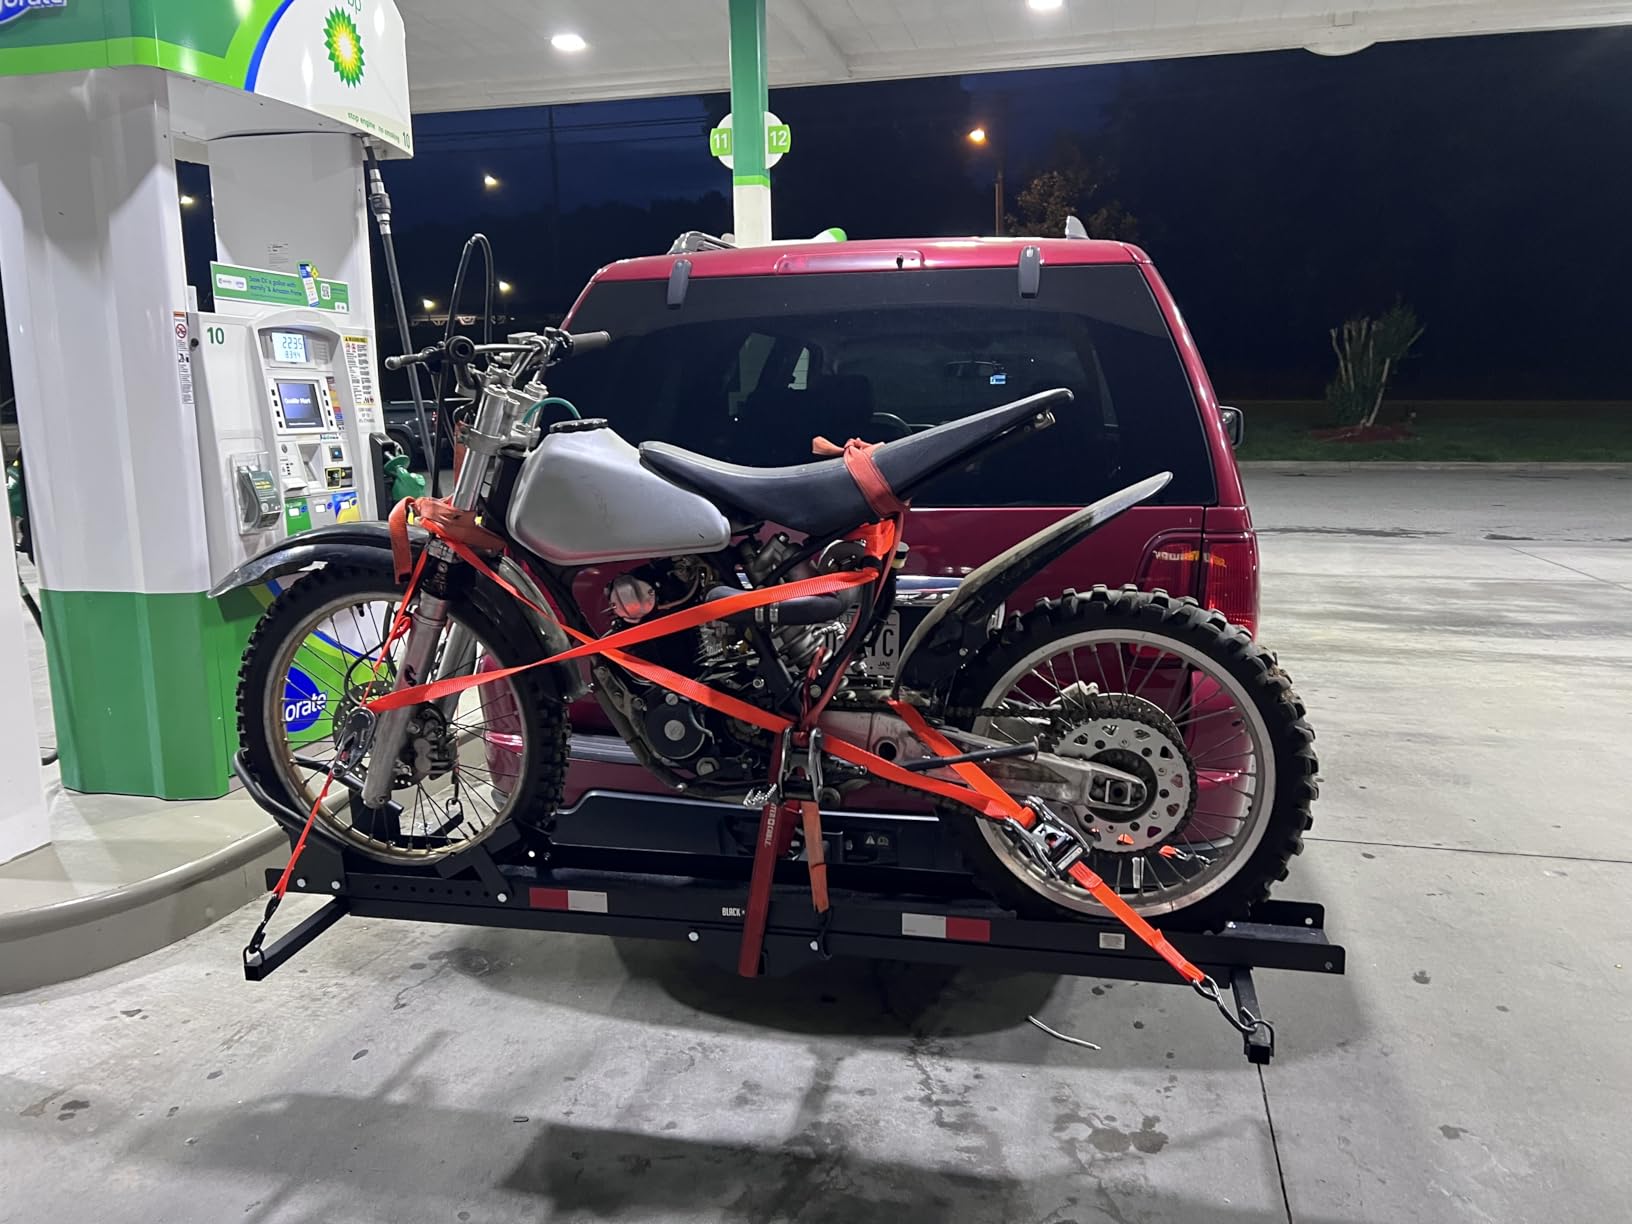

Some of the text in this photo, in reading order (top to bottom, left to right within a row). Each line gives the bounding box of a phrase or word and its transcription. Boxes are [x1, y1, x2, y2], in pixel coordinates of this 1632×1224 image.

[347, 112, 359, 122] stop
[360, 117, 375, 129] engine
[402, 131, 411, 149] 10
[714, 133, 728, 149] 11
[770, 130, 788, 147] 12
[207, 327, 225, 345] 10
[721, 907, 741, 917] BLACK
